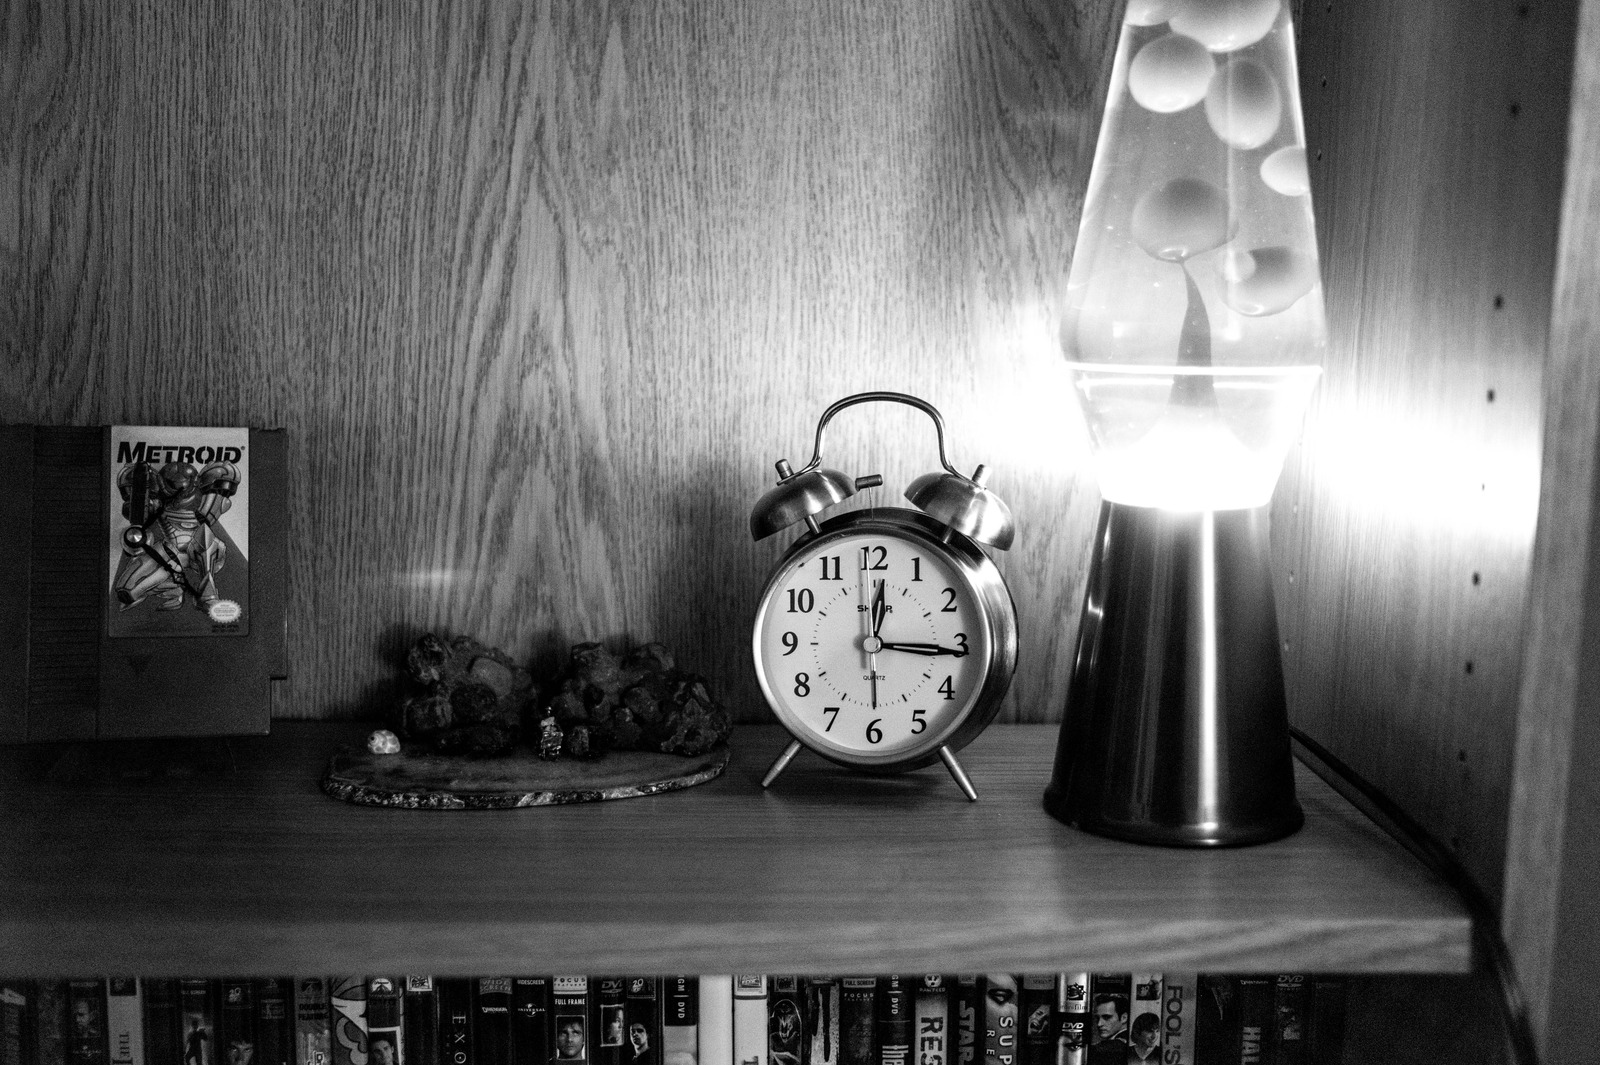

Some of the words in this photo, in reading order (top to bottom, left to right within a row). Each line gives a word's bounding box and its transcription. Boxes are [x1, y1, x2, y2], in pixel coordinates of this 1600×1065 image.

[117, 441, 242, 464] METROID
[819, 556, 844, 580] 11
[860, 545, 889, 571] 12
[911, 557, 923, 582] 1
[786, 588, 815, 613] 10
[940, 587, 958, 612] 2
[781, 631, 799, 656] 9
[953, 632, 969, 658] 3
[793, 672, 811, 697] 8
[937, 675, 956, 700] 4
[823, 707, 840, 732] 7
[866, 718, 883, 744] 6
[910, 709, 927, 734] 5
[1277, 974, 1304, 983] DVD
[677, 1001, 686, 1019] DVD
[891, 997, 899, 1015] DVD
[1062, 1022, 1085, 1030] DVD
[1164, 985, 1183, 1065] FOOL'S
